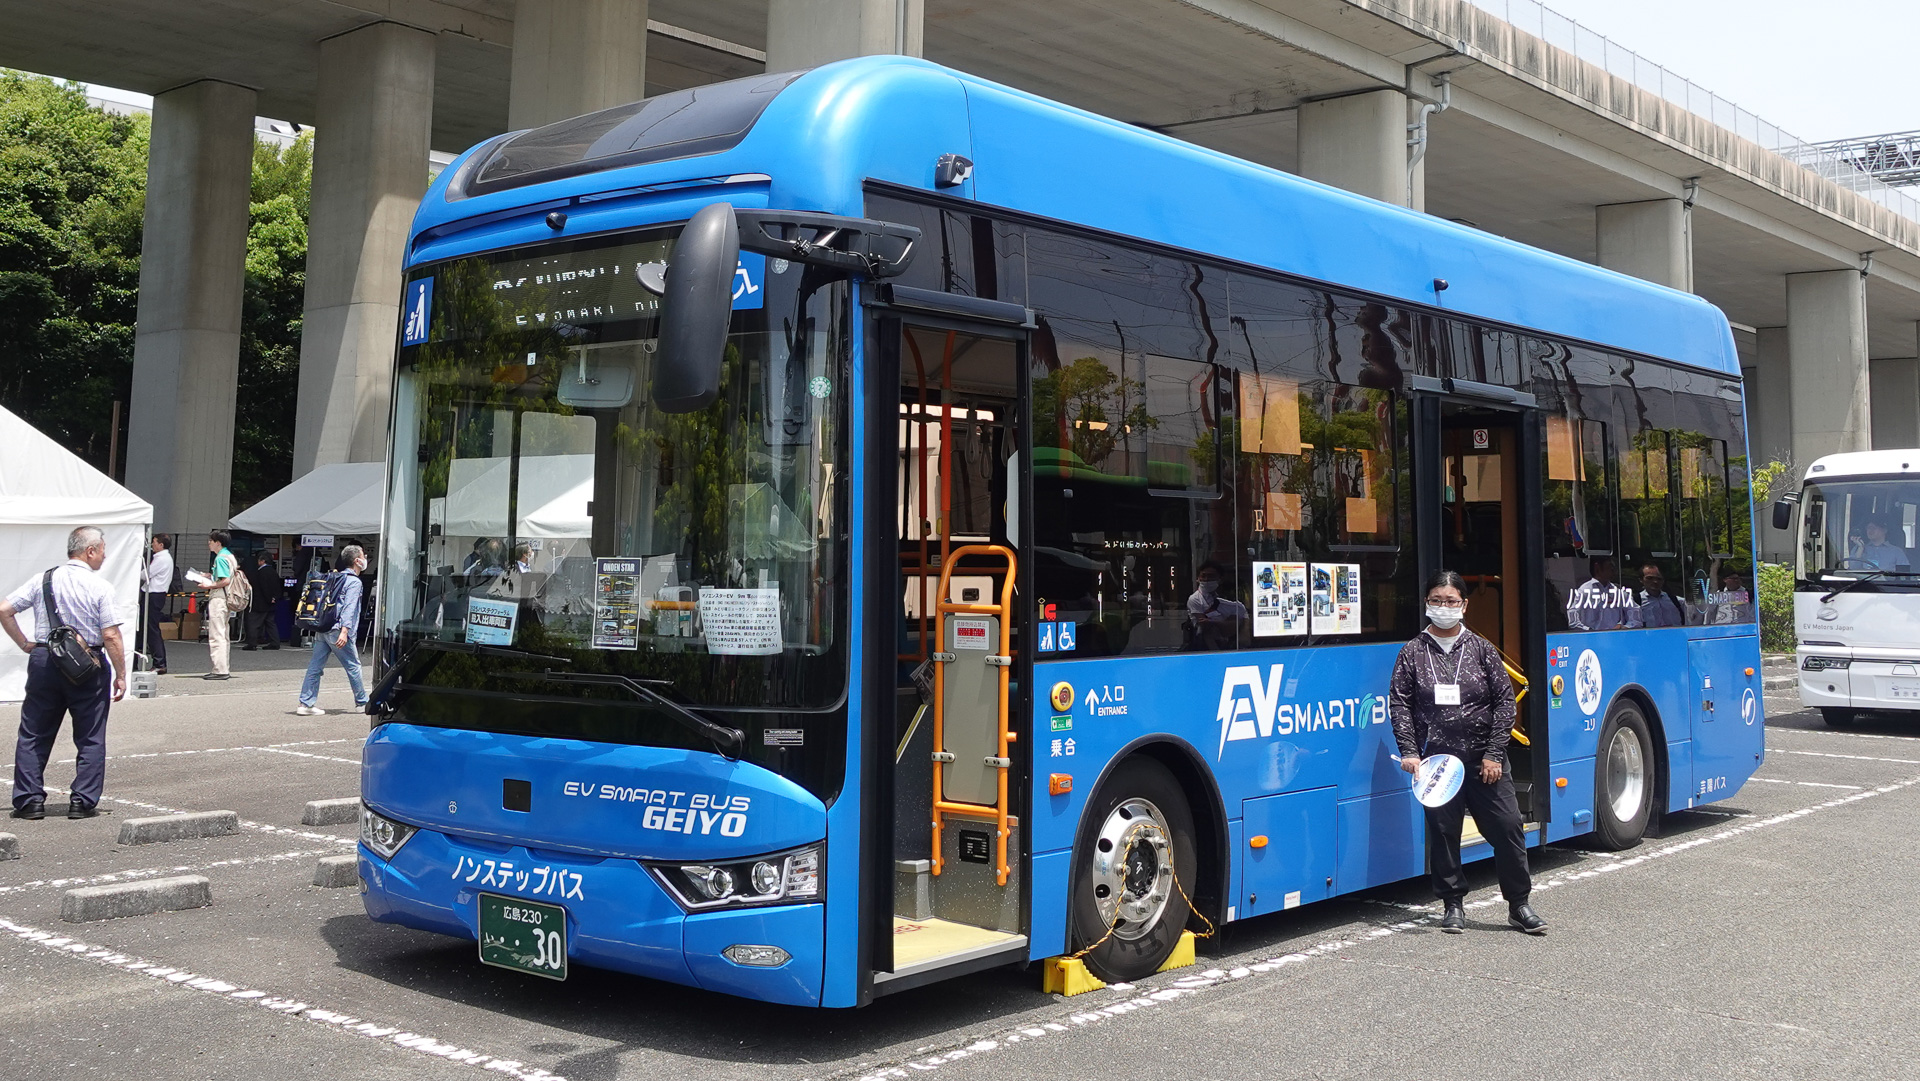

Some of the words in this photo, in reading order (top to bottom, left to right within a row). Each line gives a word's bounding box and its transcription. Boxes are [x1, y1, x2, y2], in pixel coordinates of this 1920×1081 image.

[1566, 585, 1634, 610] ノンステップバス
[1558, 660, 1568, 668] EXIT
[1101, 685, 1125, 703] 入口
[1097, 705, 1128, 717] ENTRANCE
[1277, 697, 1360, 735] SMART
[1584, 718, 1596, 731] ユリ
[1050, 737, 1077, 758] 乗合
[563, 781, 596, 797] EV
[599, 784, 686, 806] SMART
[690, 793, 751, 811] BUS
[642, 805, 747, 837] GEIYO
[451, 855, 584, 901] ノンステップバス
[532, 928, 561, 970] 30
